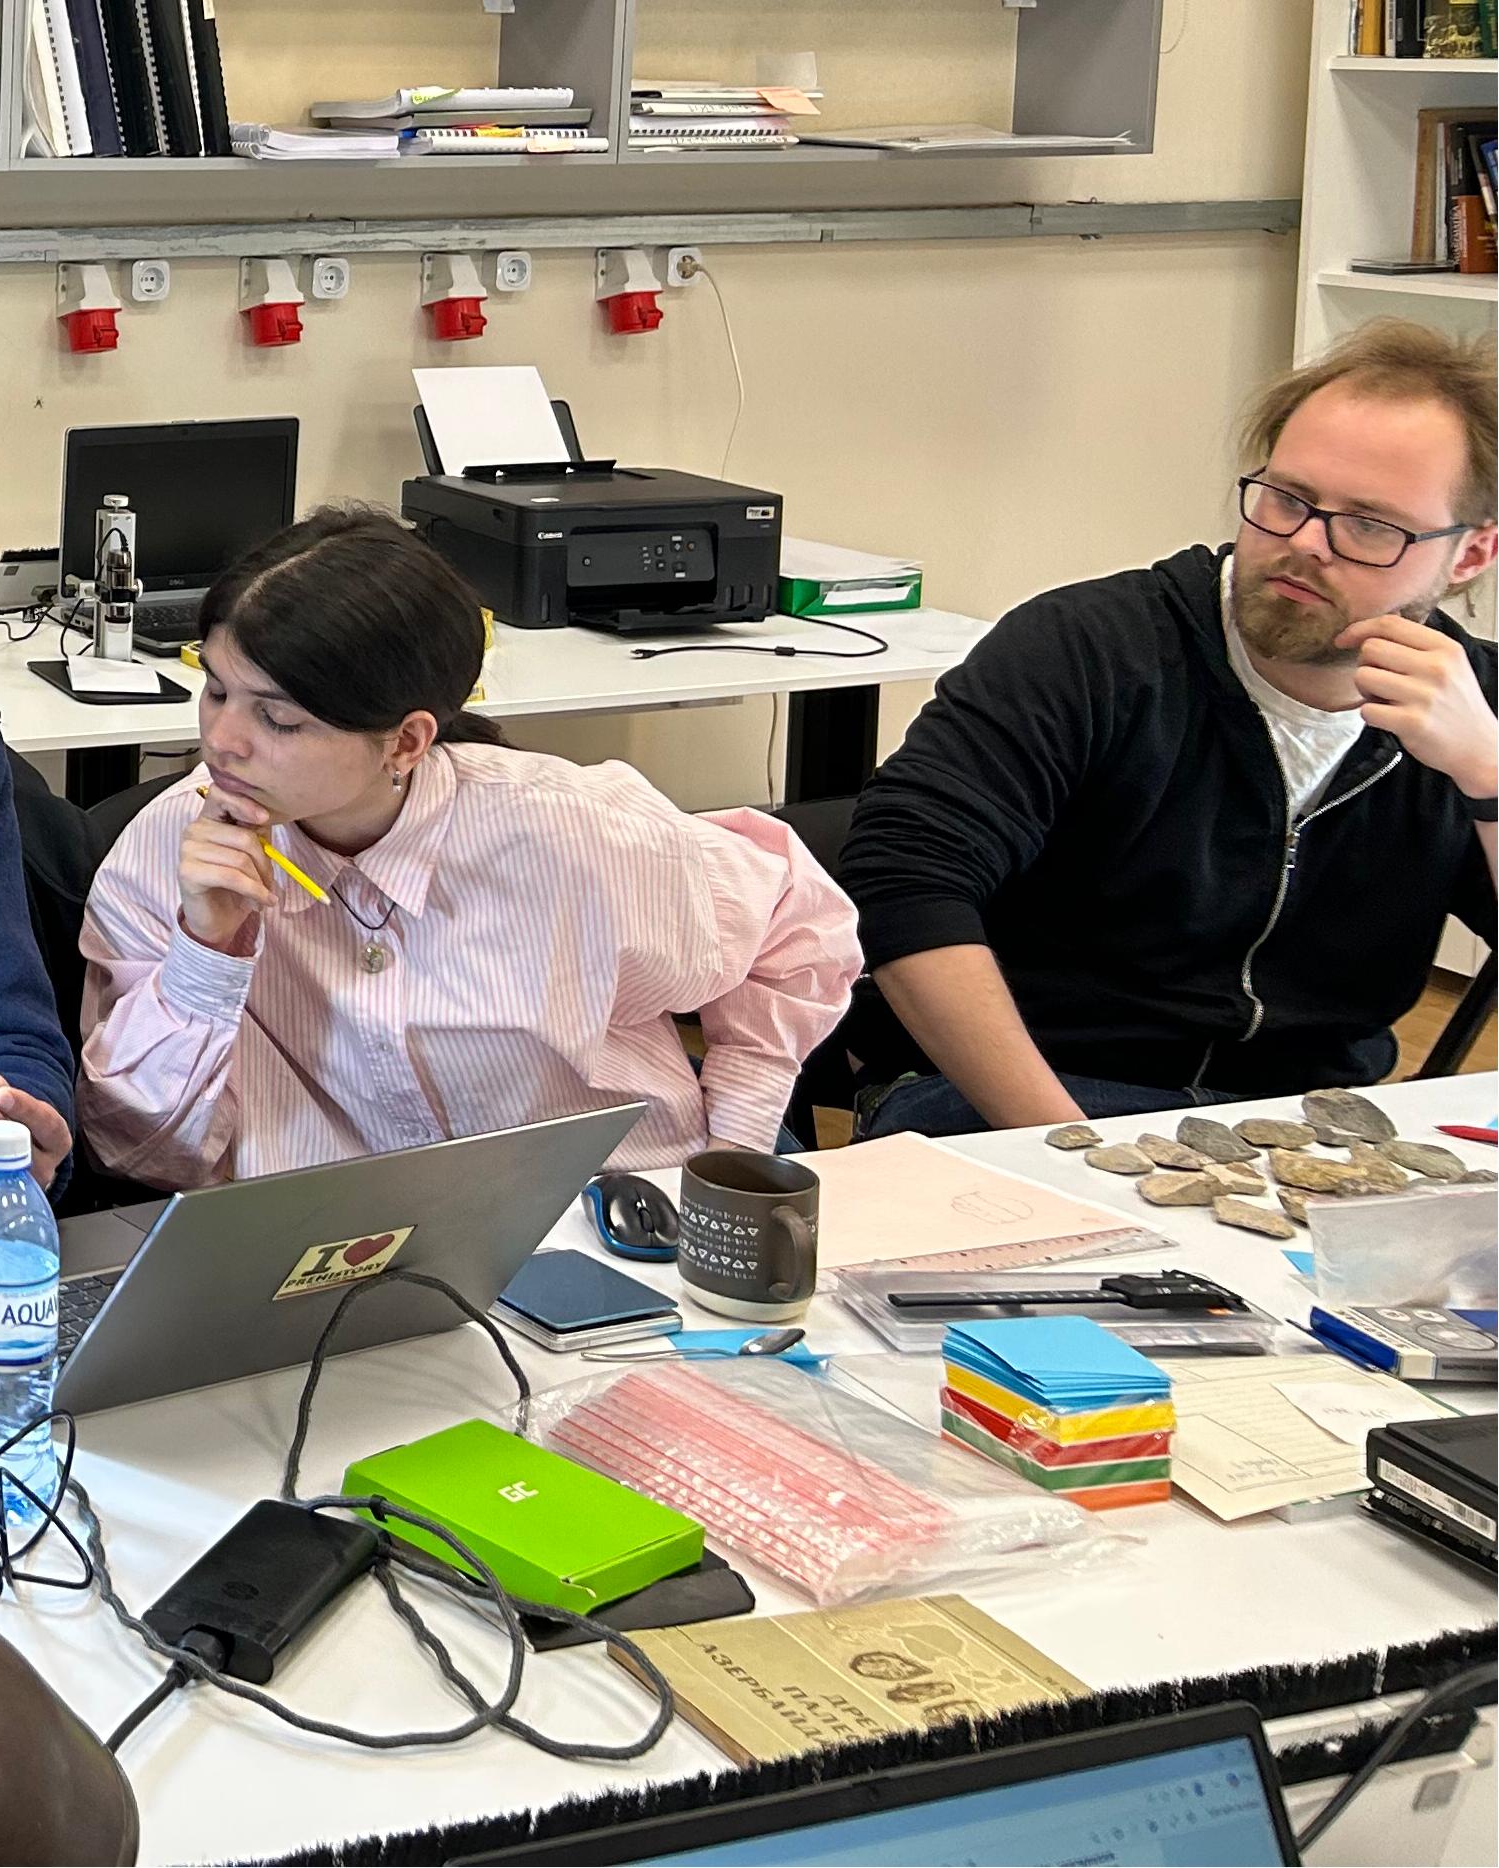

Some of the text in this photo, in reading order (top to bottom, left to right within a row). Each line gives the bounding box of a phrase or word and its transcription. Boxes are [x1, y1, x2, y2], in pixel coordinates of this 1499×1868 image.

[301, 1242, 348, 1277] I
[284, 1260, 386, 1288] PREHISTORY
[497, 1480, 540, 1503] GC
